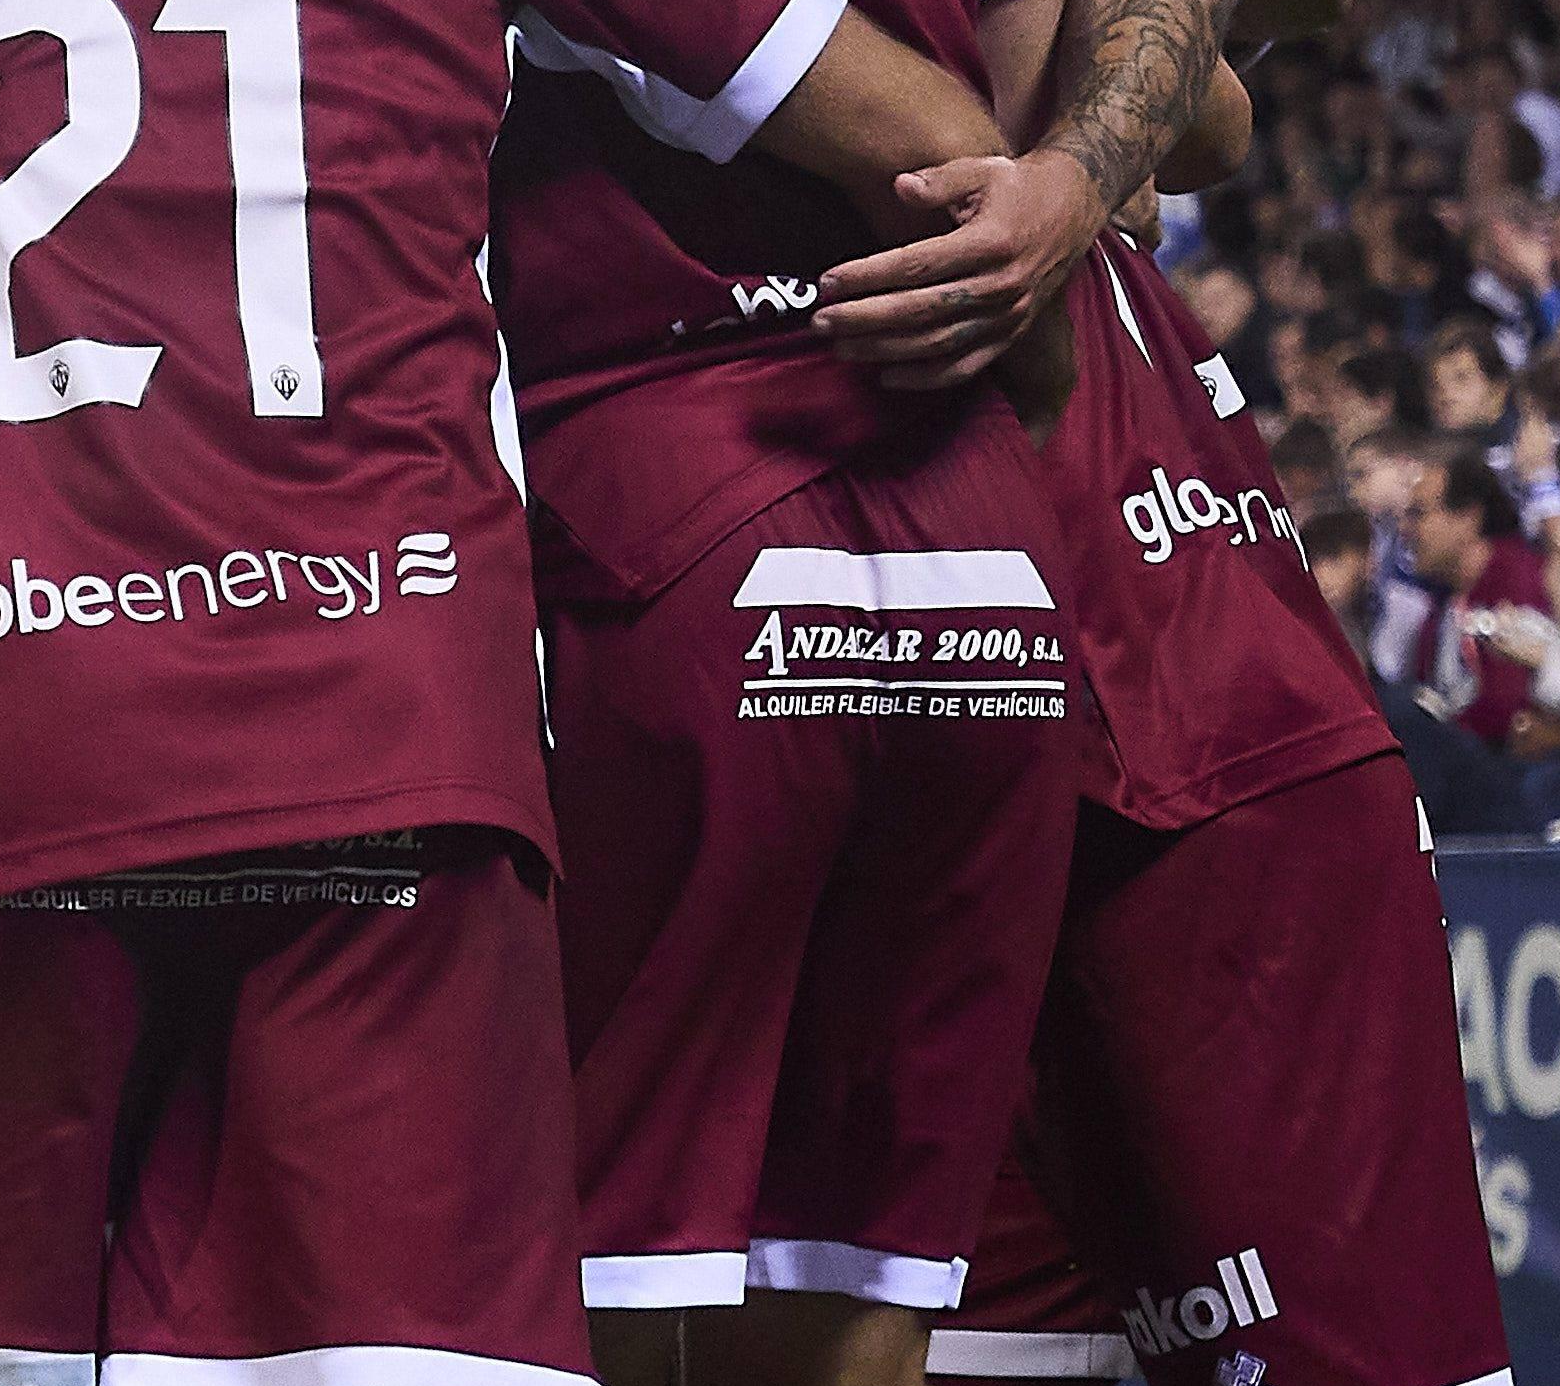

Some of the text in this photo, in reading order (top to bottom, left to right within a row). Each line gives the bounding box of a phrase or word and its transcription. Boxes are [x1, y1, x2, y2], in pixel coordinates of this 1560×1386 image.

[931, 629, 1028, 668] 2000,
[738, 694, 834, 718] ALQUILER
[928, 696, 961, 717] DE
[967, 692, 1064, 718] VEHÍCULOS
[122, 885, 234, 909] FLEXIBLE
[240, 883, 274, 904] DE
[281, 876, 417, 908] VEHÍCULOS
